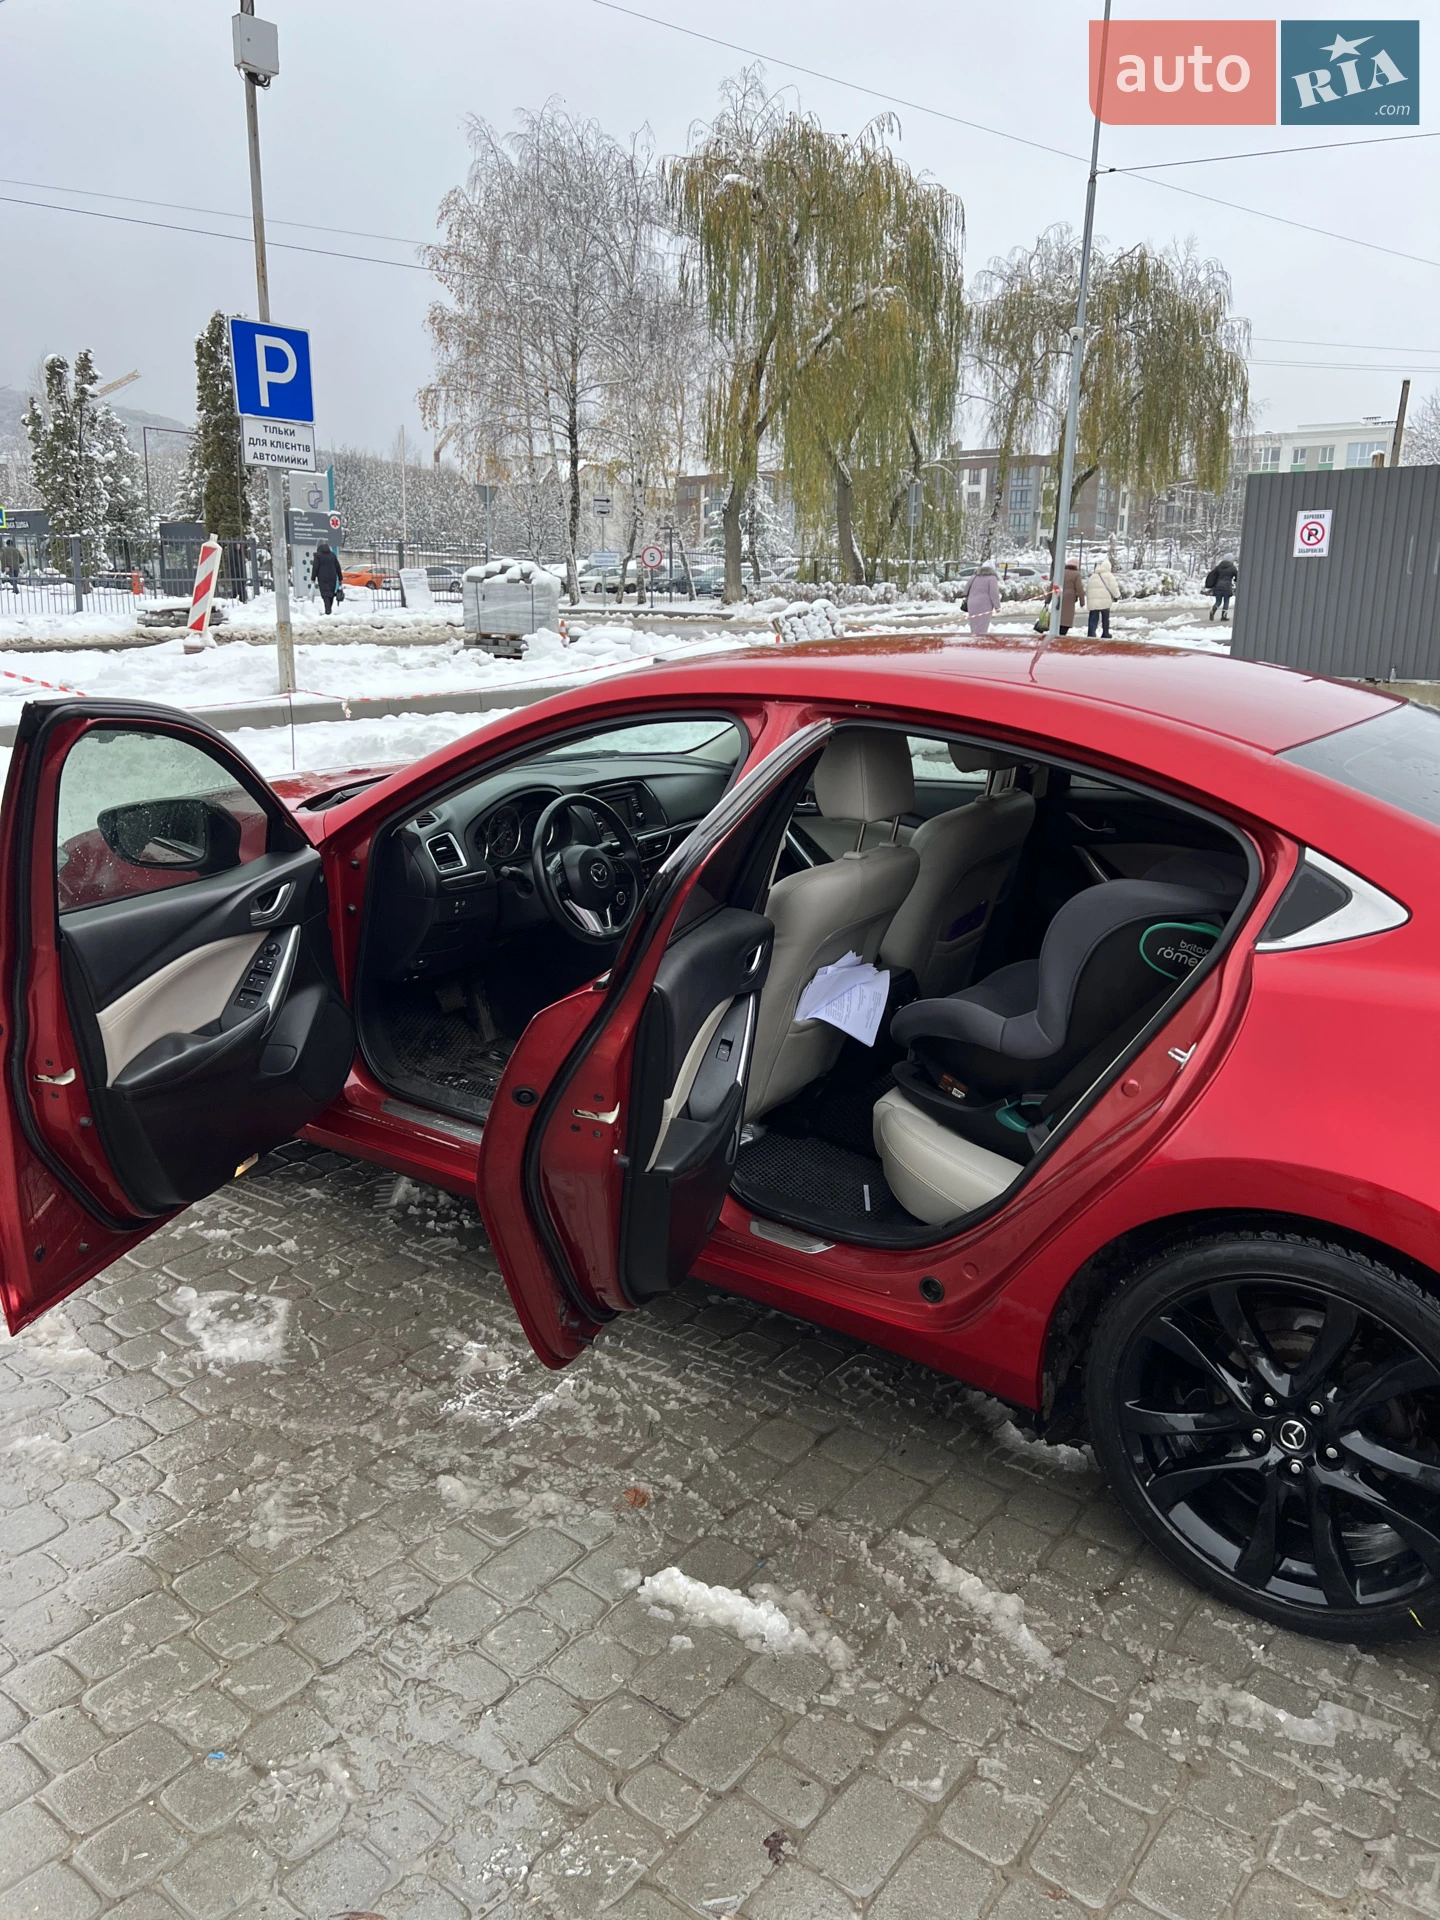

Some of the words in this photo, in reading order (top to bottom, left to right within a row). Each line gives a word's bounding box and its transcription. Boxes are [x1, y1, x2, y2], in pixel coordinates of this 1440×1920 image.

[254, 333, 298, 408] P
[263, 424, 296, 437] ТІЛЬКИ
[248, 437, 268, 447] ДЛЯ
[269, 439, 311, 453] КЛІЄНТІВ
[252, 451, 309, 466] АВТОМИЙКИ
[649, 552, 655, 561] 5
[1179, 940, 1210, 955] britax
[1156, 946, 1199, 967] röme
